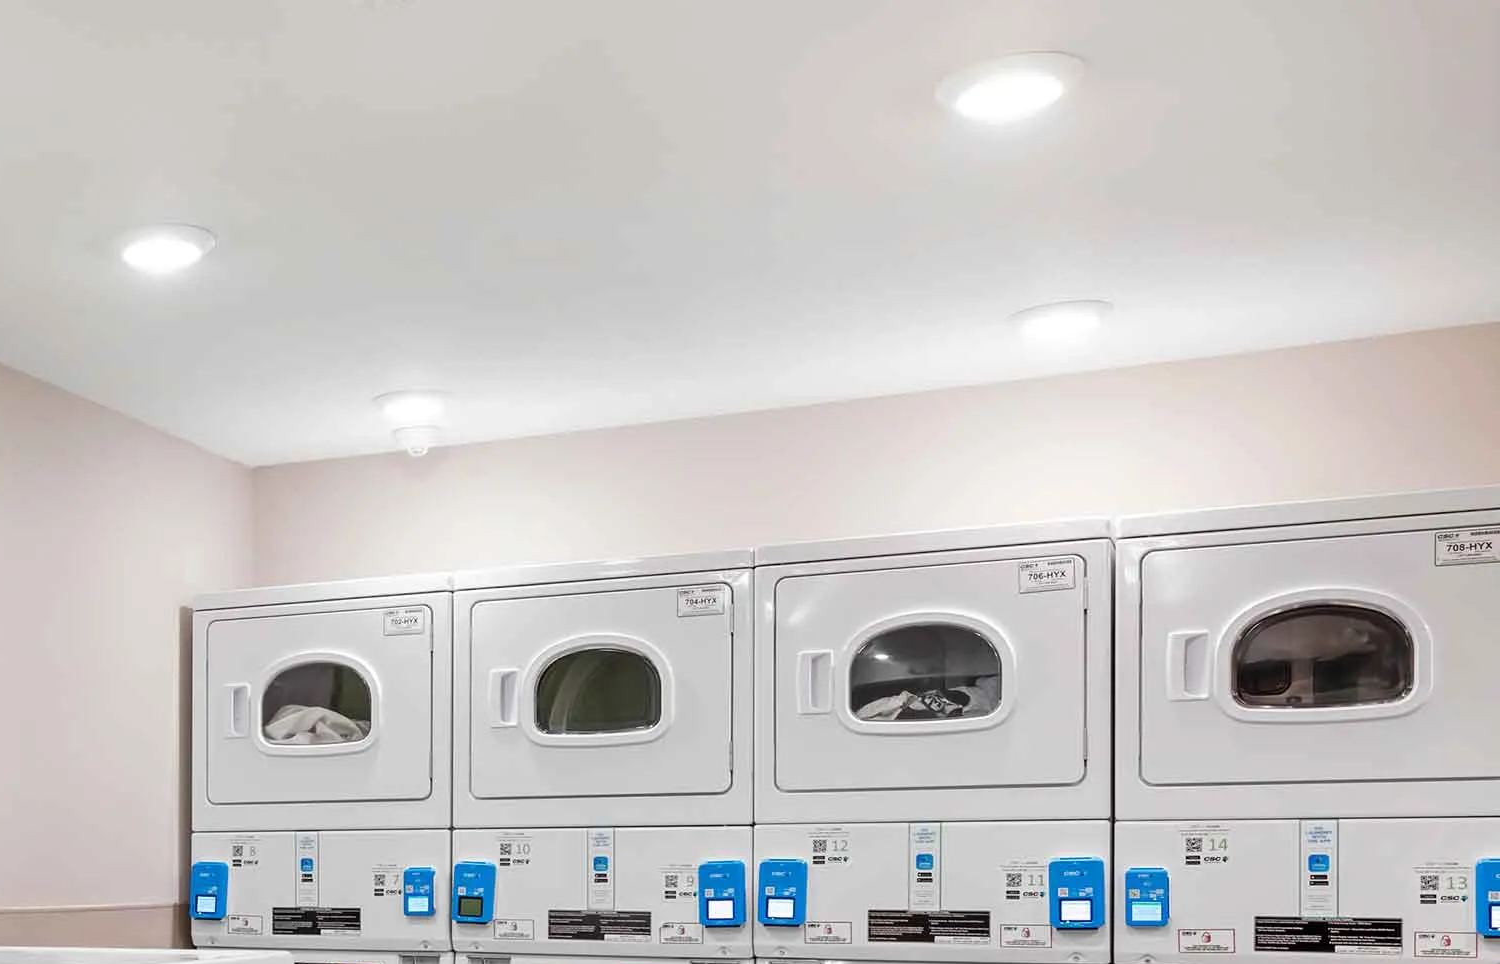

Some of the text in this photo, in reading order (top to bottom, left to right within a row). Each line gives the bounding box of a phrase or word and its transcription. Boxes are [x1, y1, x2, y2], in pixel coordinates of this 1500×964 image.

[1445, 541, 1493, 552] 708-HYX
[516, 843, 531, 855] 10
[832, 840, 849, 852] 12
[1209, 838, 1228, 851] 14
[1028, 874, 1044, 886] 11
[1446, 876, 1468, 890] 13
